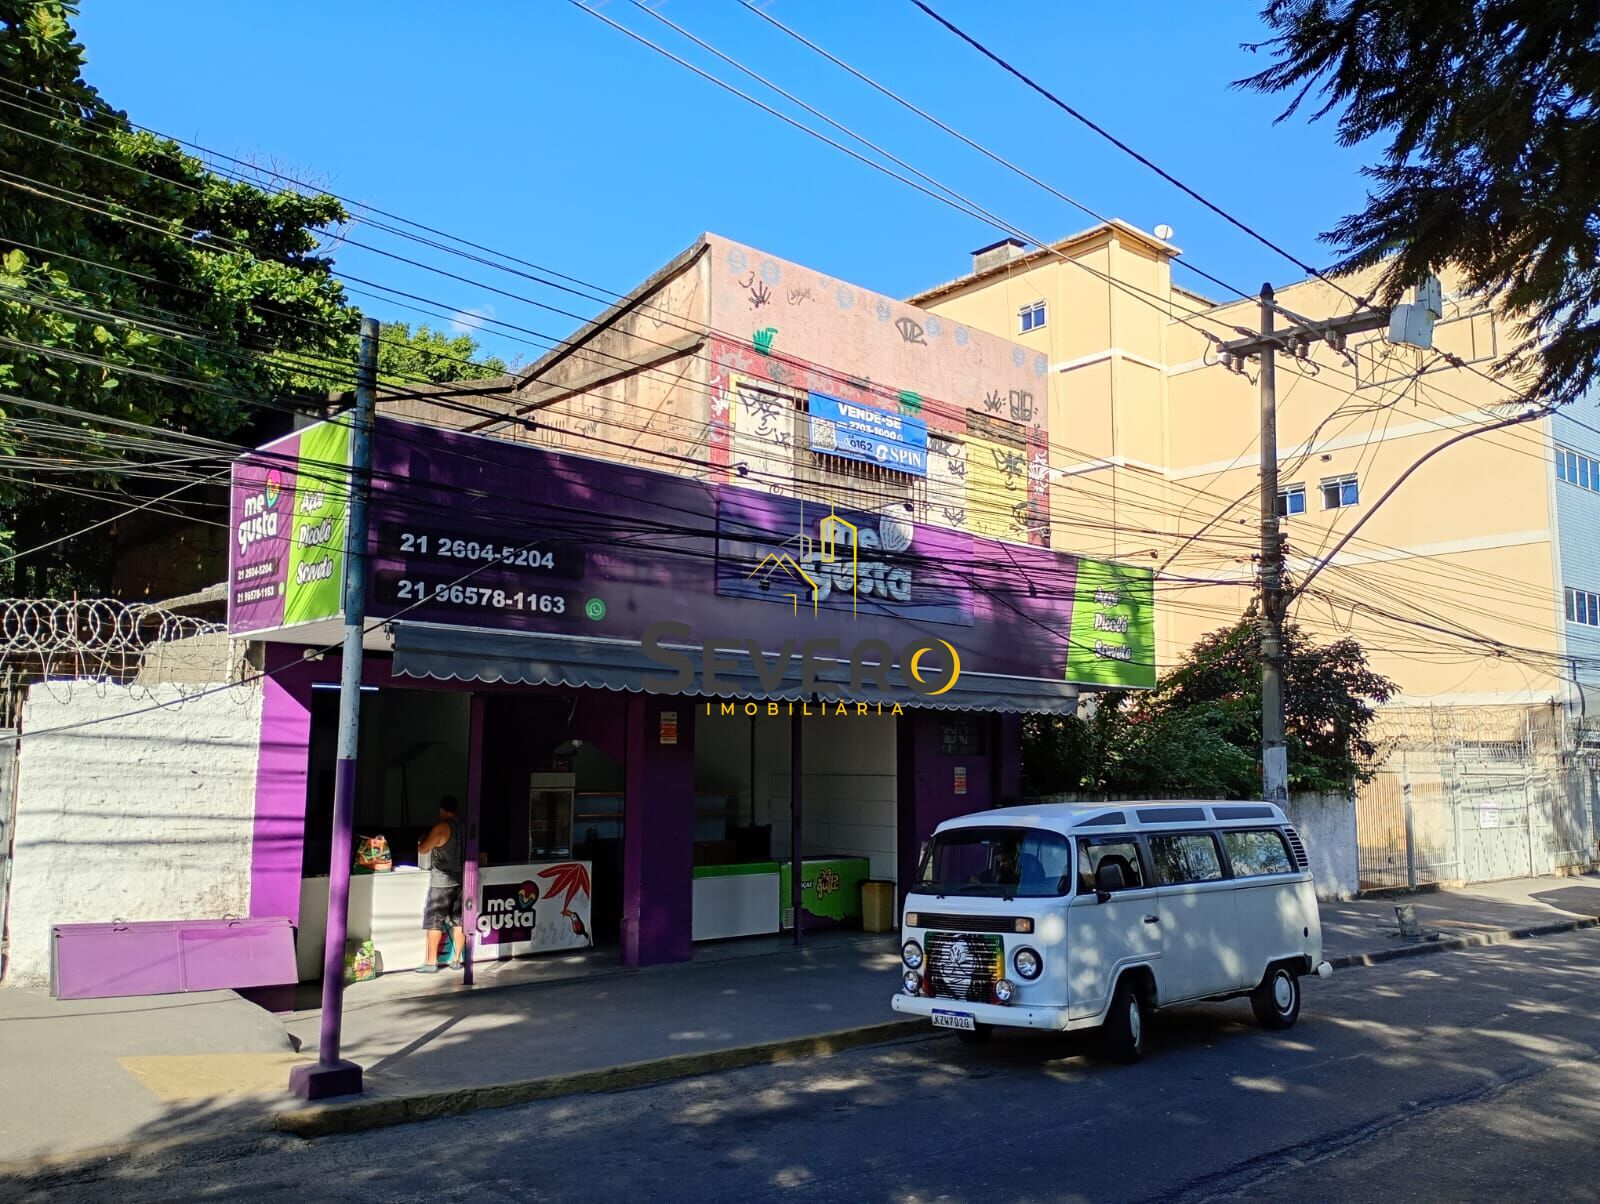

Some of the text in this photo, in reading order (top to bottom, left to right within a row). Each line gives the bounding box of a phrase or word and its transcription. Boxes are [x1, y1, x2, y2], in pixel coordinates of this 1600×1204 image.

[838, 402, 901, 430] VENDE-SE
[849, 439, 873, 453] 0162
[890, 447, 922, 467] SPIN
[244, 493, 265, 518] me
[238, 511, 278, 555] gusta
[400, 533, 555, 569] 21 2604-5204
[237, 570, 245, 580] 21
[237, 592, 244, 603] 21
[397, 580, 566, 614] 21 96578-1163
[487, 898, 516, 912] me
[477, 909, 534, 938] gusta
